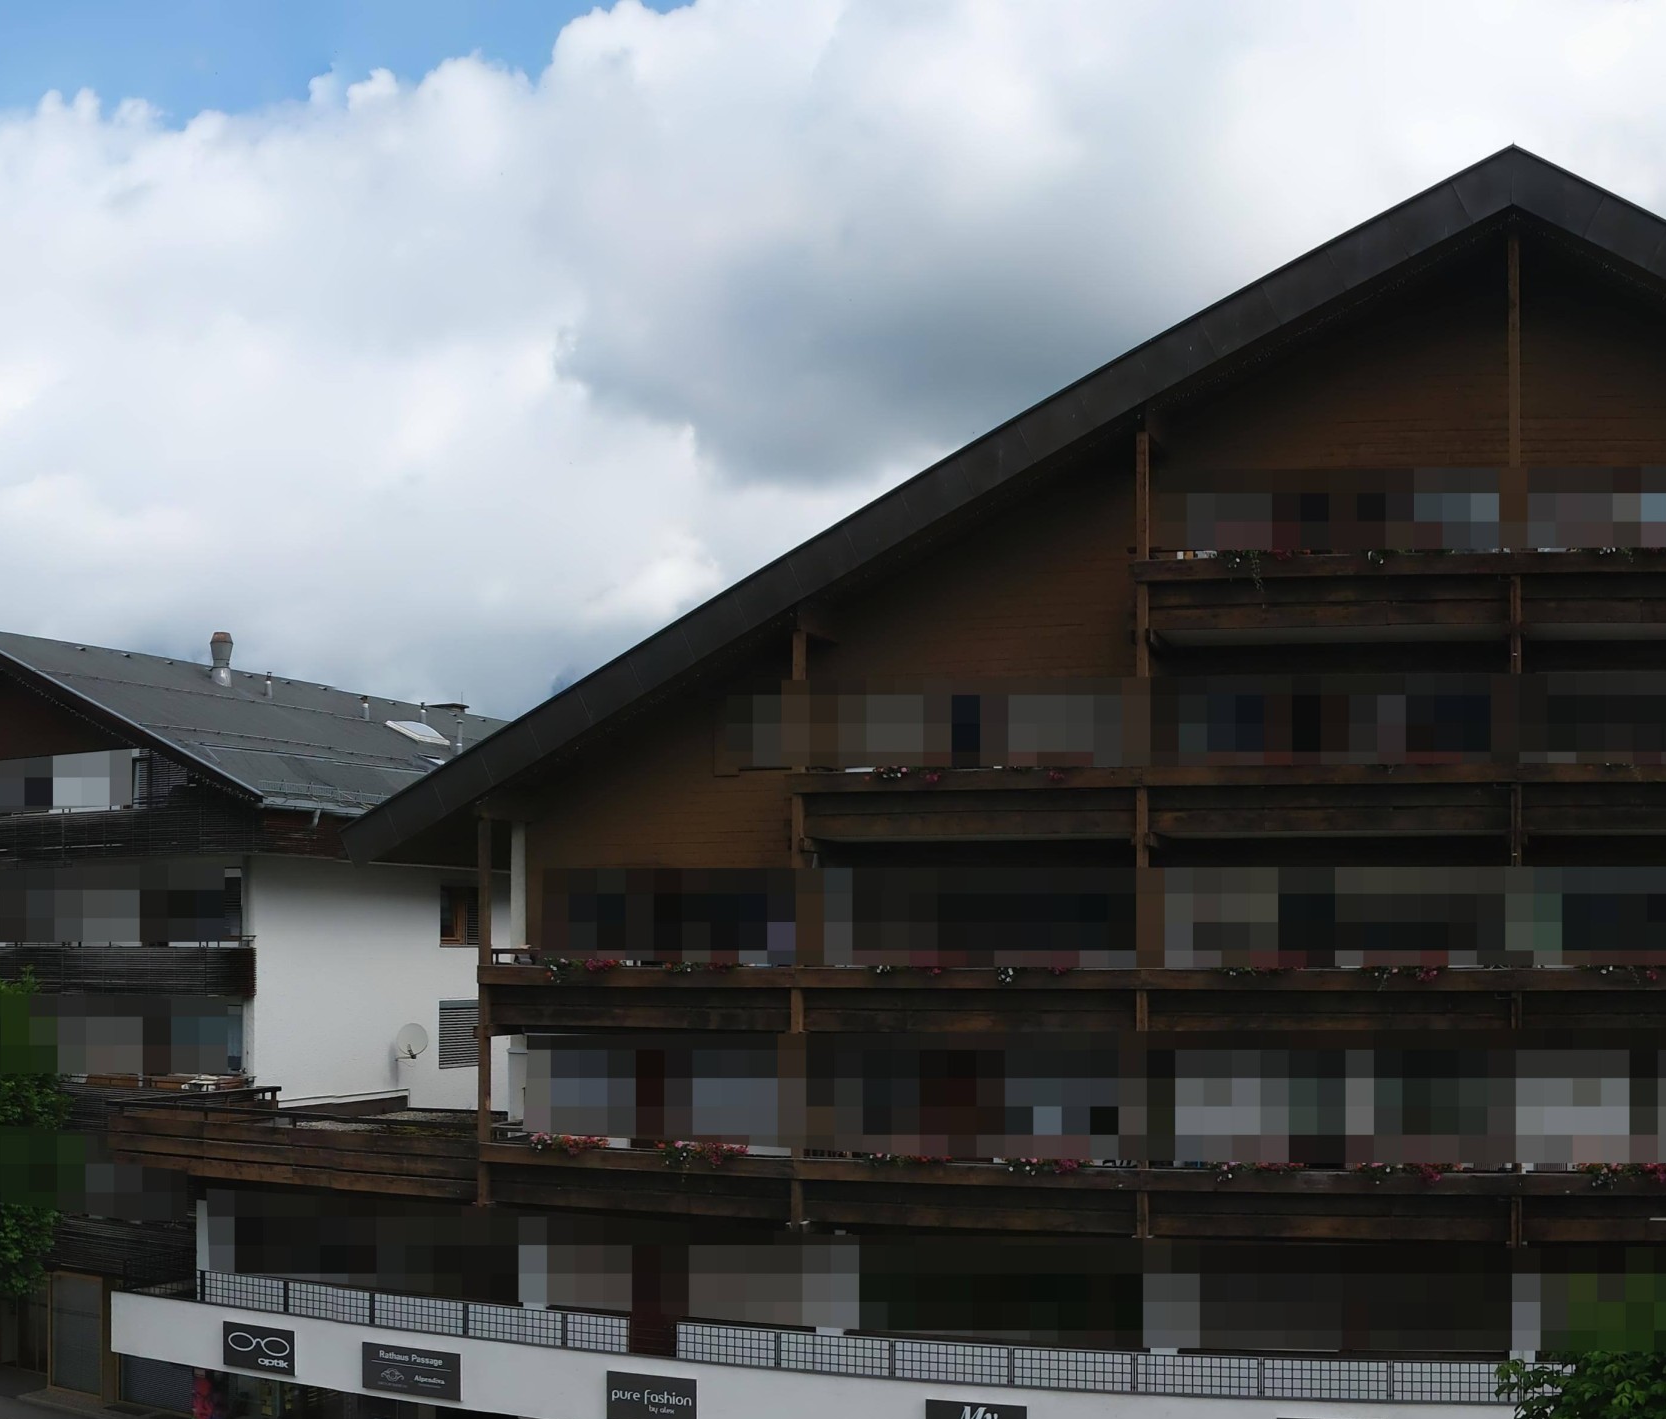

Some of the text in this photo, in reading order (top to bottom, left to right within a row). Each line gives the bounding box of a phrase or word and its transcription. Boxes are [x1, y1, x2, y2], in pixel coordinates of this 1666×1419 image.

[257, 1357, 289, 1369] optik
[379, 1349, 443, 1366] Rathaus Passage
[611, 1389, 692, 1407] pure fashion
[648, 1404, 675, 1415] by alex
